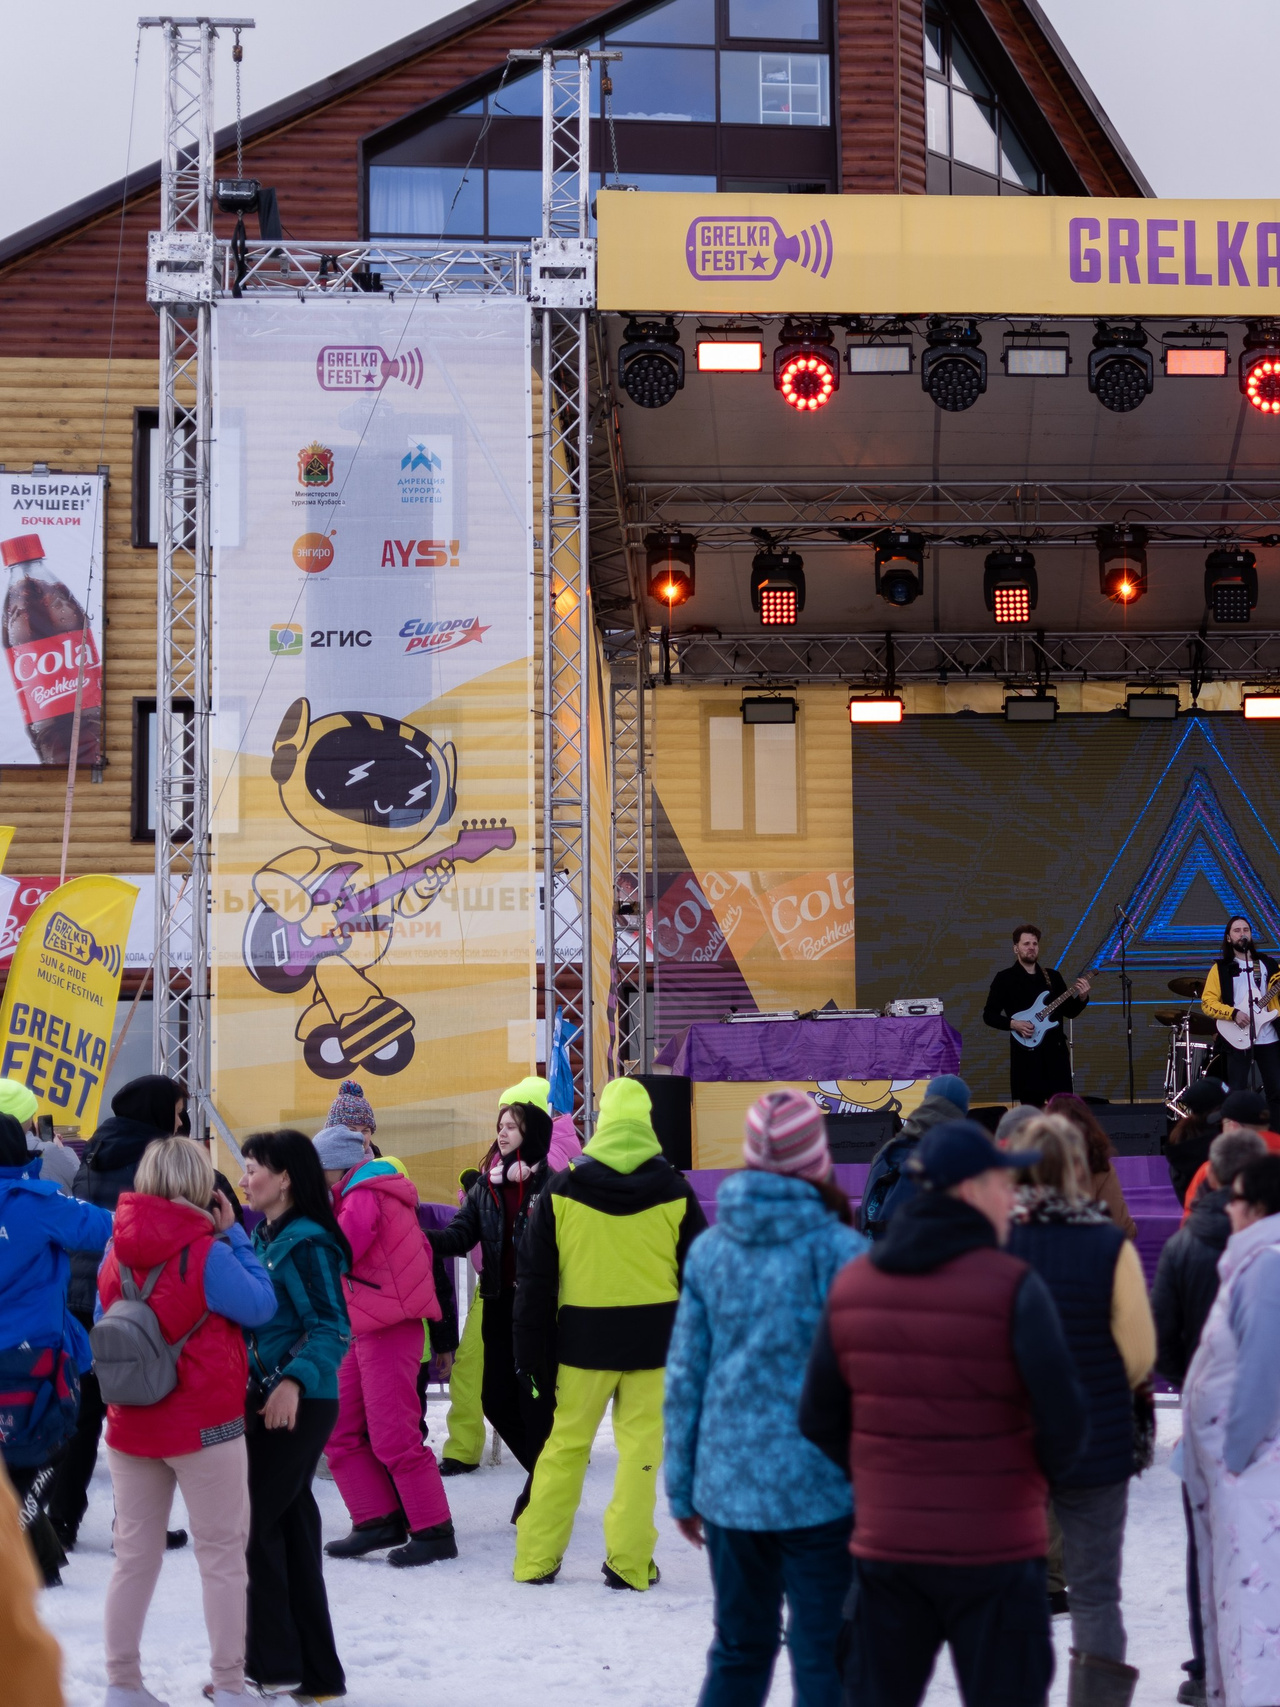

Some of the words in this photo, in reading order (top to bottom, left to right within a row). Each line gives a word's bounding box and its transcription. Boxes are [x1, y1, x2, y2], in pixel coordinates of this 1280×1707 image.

[701, 226, 769, 246] GRELKA
[701, 251, 747, 271] FEST
[327, 352, 377, 367] GRELKA
[327, 369, 361, 384] FEST
[11, 482, 92, 496] ВЫБИРАЙ
[21, 516, 81, 526] БОЧКАРИ
[381, 540, 460, 567] AYS!
[310, 630, 373, 647] 2ГИС
[14, 639, 94, 681] Cola
[31, 676, 90, 704] Bochka
[47, 933, 75, 953] FEST
[54, 918, 88, 946] GRELKA
[40, 953, 58, 970] SUN
[58, 963, 66, 974] &
[67, 965, 87, 983] RIDE
[37, 968, 65, 989] MUSIC
[66, 981, 104, 1007] FESTIVAL
[9, 1002, 107, 1072] GRELKA
[1, 1041, 99, 1118] FEST
